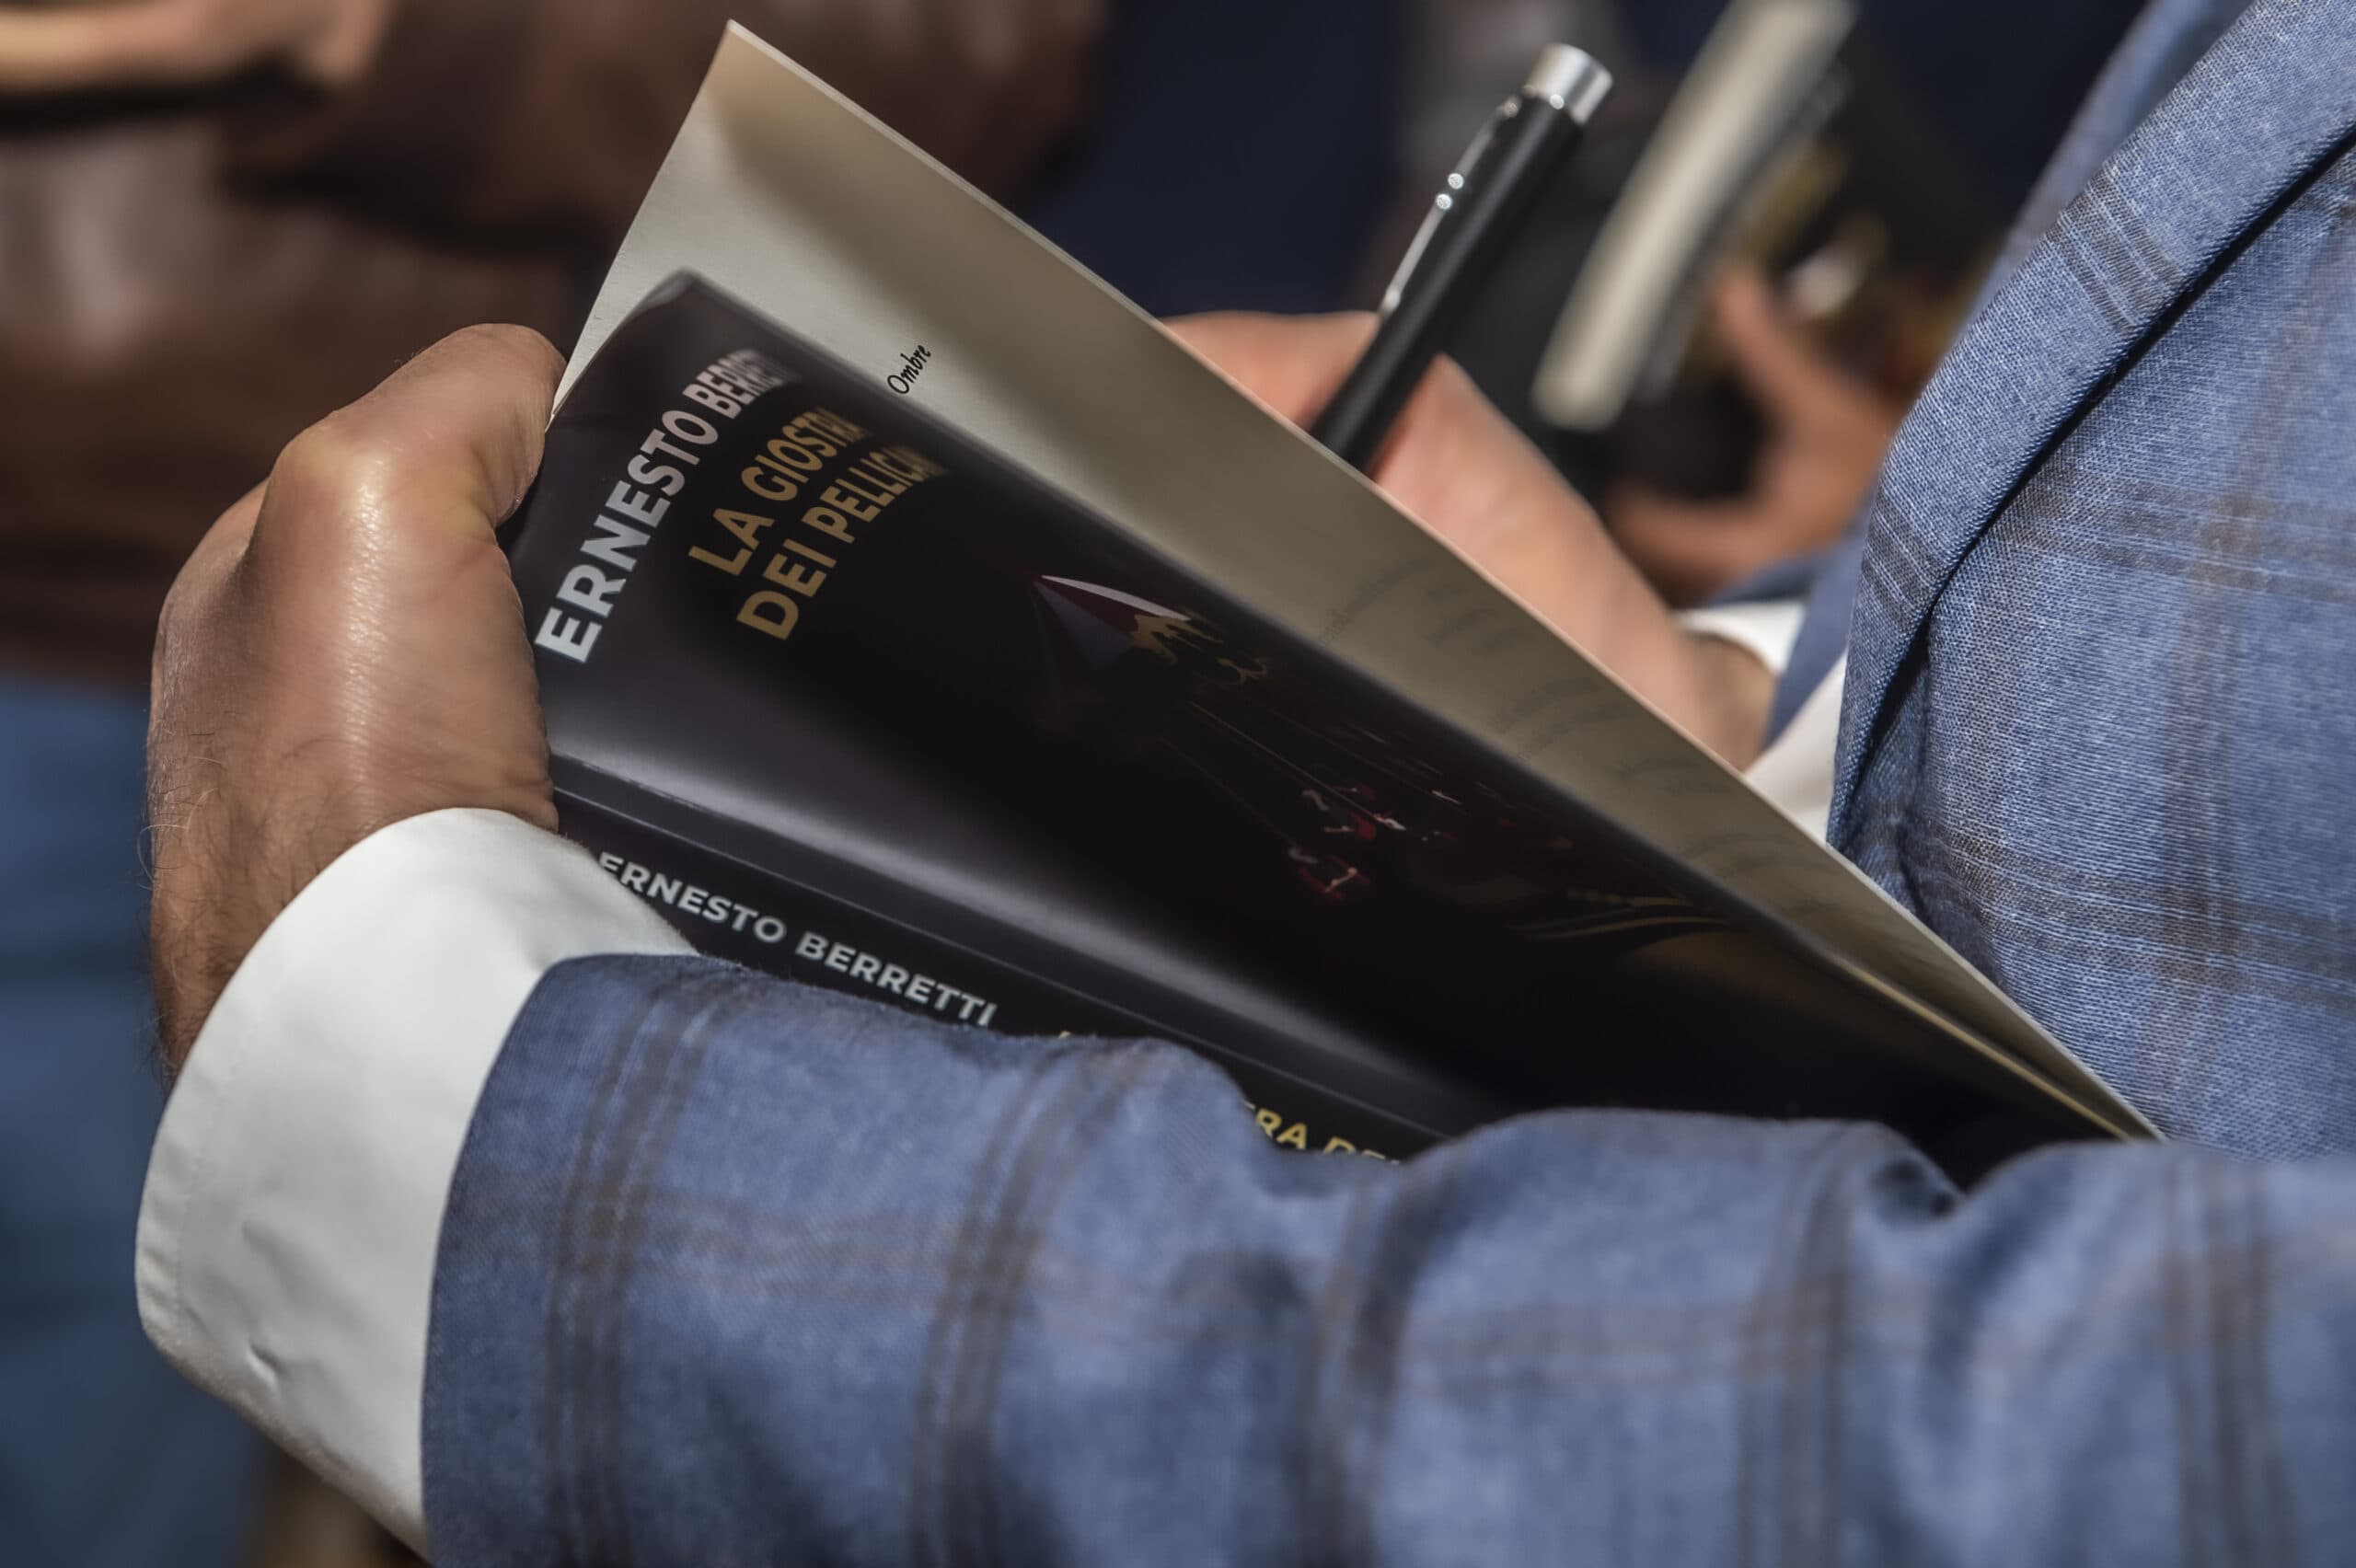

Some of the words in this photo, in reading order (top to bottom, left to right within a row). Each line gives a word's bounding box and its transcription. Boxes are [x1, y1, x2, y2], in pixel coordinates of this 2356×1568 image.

[887, 344, 931, 394] Ombre
[534, 409, 719, 663] ERNESTO
[682, 349, 793, 419] BERR
[688, 507, 775, 576] LA
[736, 538, 837, 640] DEI
[599, 851, 787, 943] ERNESTO
[795, 931, 998, 1026] BERRETTI
